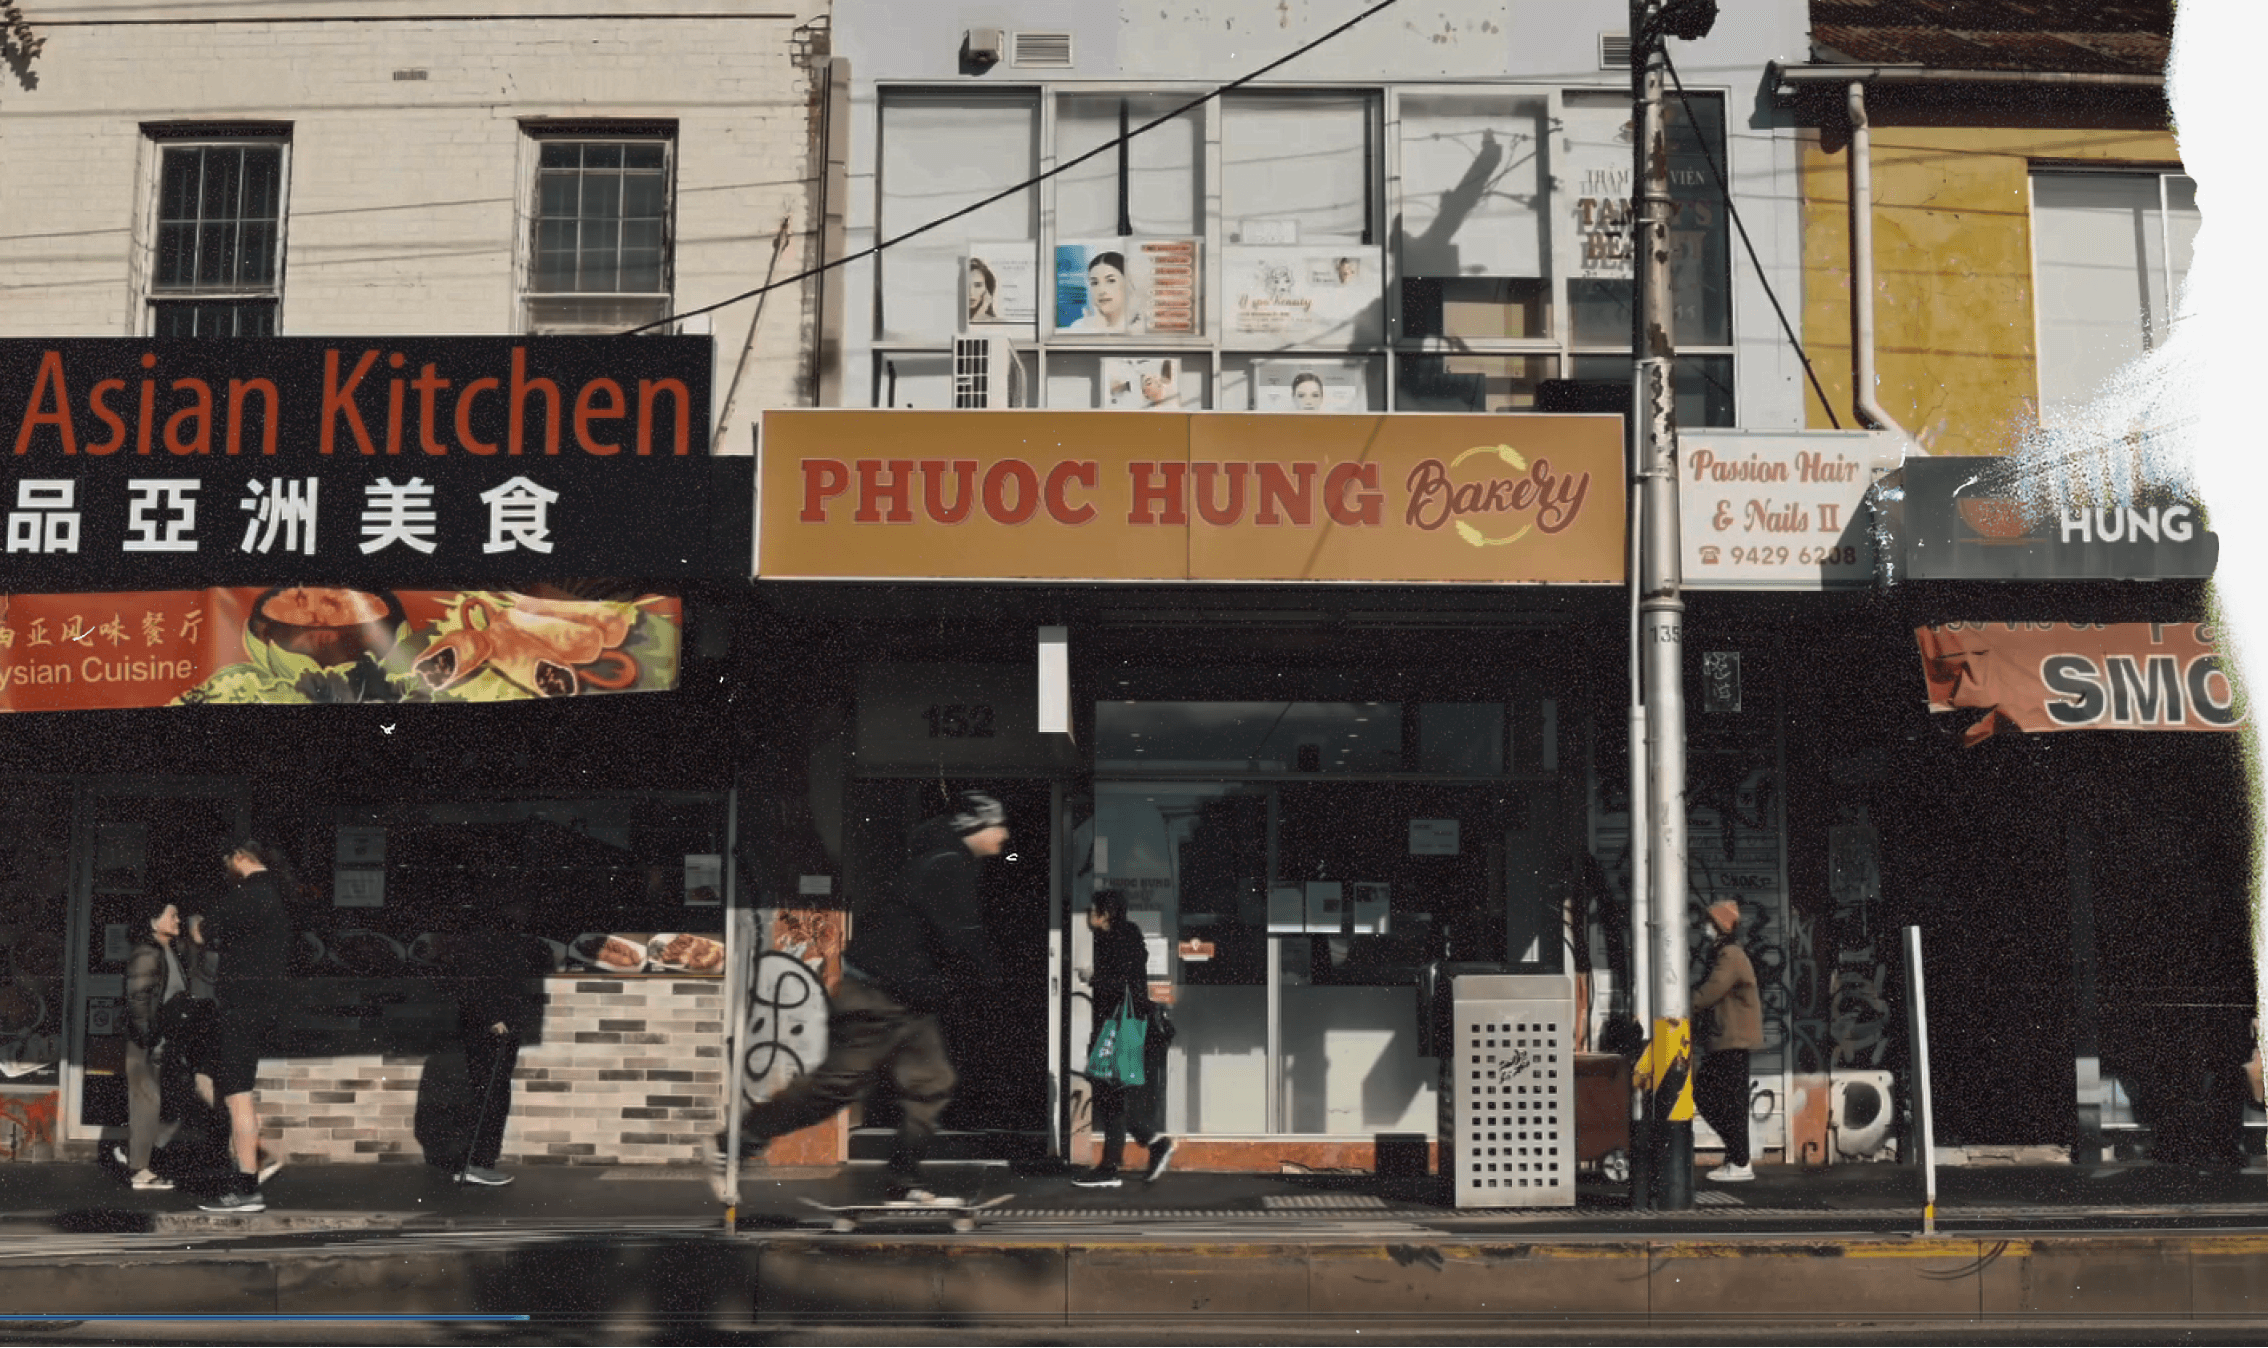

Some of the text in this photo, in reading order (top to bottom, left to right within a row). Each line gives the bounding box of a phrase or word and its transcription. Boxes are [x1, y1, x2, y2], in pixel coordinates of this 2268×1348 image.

[13, 347, 690, 456] Asian Kitchen
[1689, 449, 1859, 483] Passion Hair
[799, 454, 1591, 535] PHUOC HUNG Bakery
[6, 476, 560, 555] 品亞洲美食
[1712, 499, 1734, 532] &
[1744, 498, 1809, 534] Nails
[2060, 504, 2194, 544] HUNG
[1730, 545, 1857, 566] 9429 6208
[1649, 624, 1681, 644] 135
[80, 654, 193, 684] Cuisine
[921, 703, 996, 739] 152
